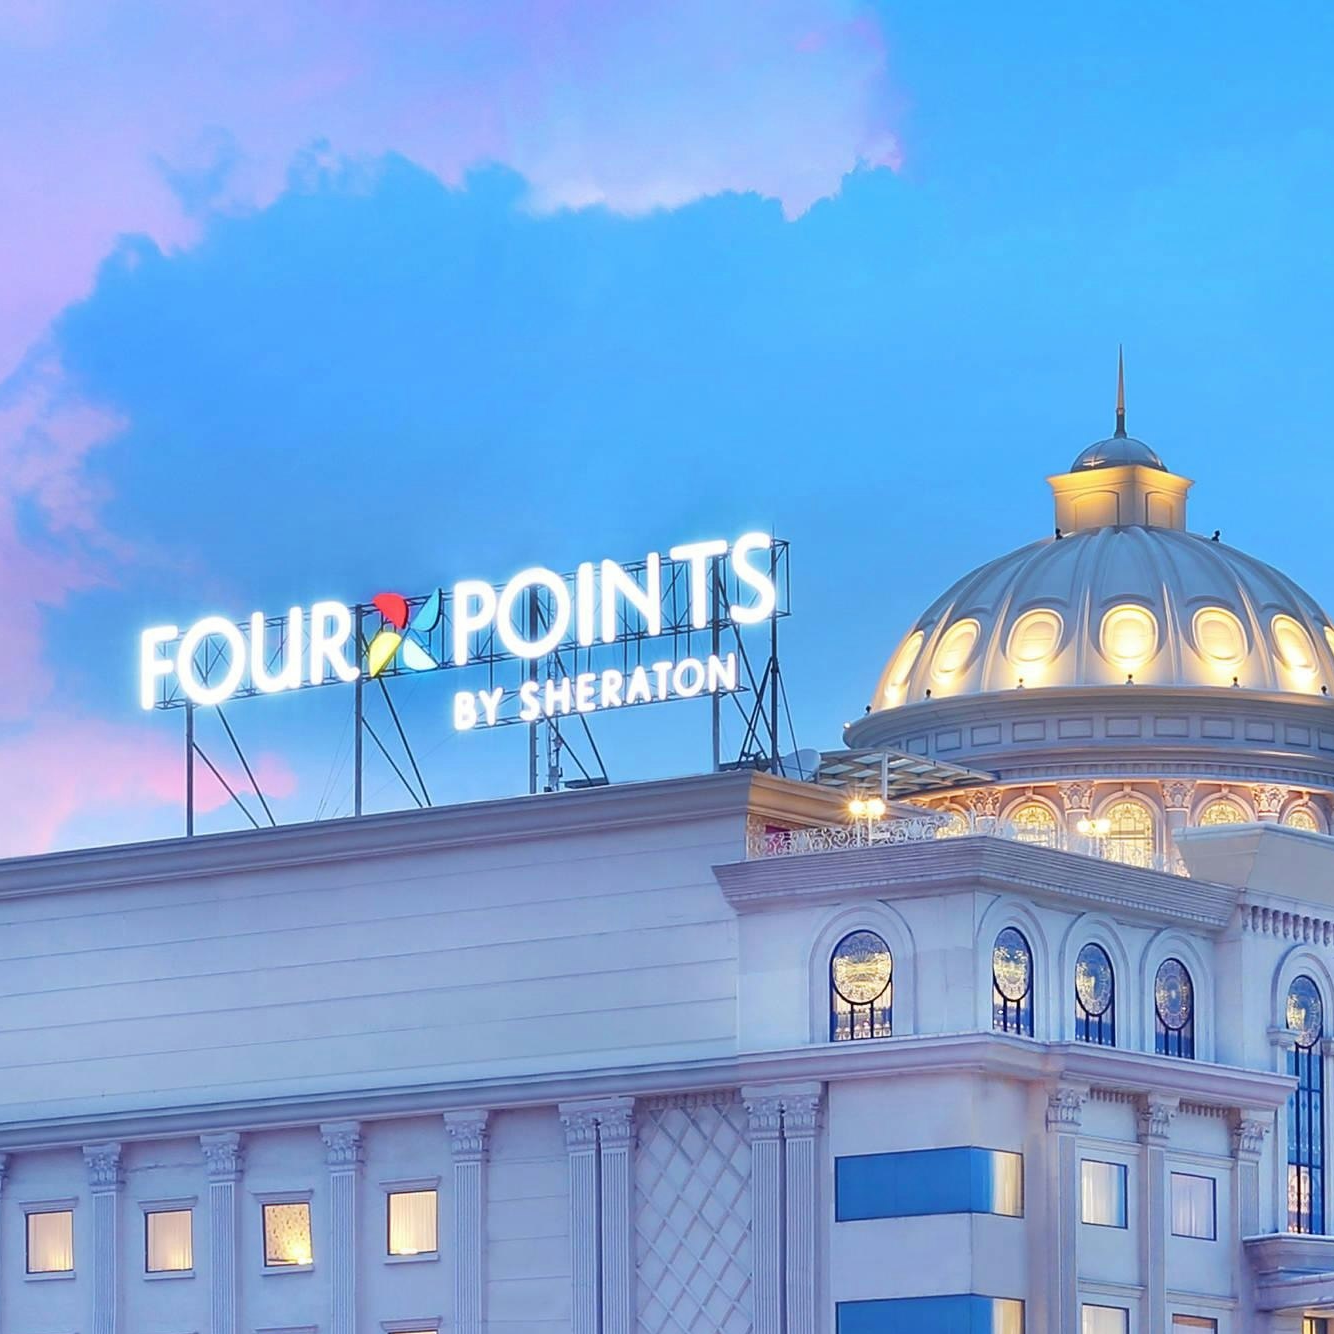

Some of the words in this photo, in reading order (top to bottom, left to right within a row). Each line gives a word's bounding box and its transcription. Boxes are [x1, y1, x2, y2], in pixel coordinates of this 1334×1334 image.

[141, 601, 359, 709] FOUR
[454, 532, 776, 665] POINTS
[454, 687, 504, 730] BY
[519, 653, 737, 721] SHERATON
